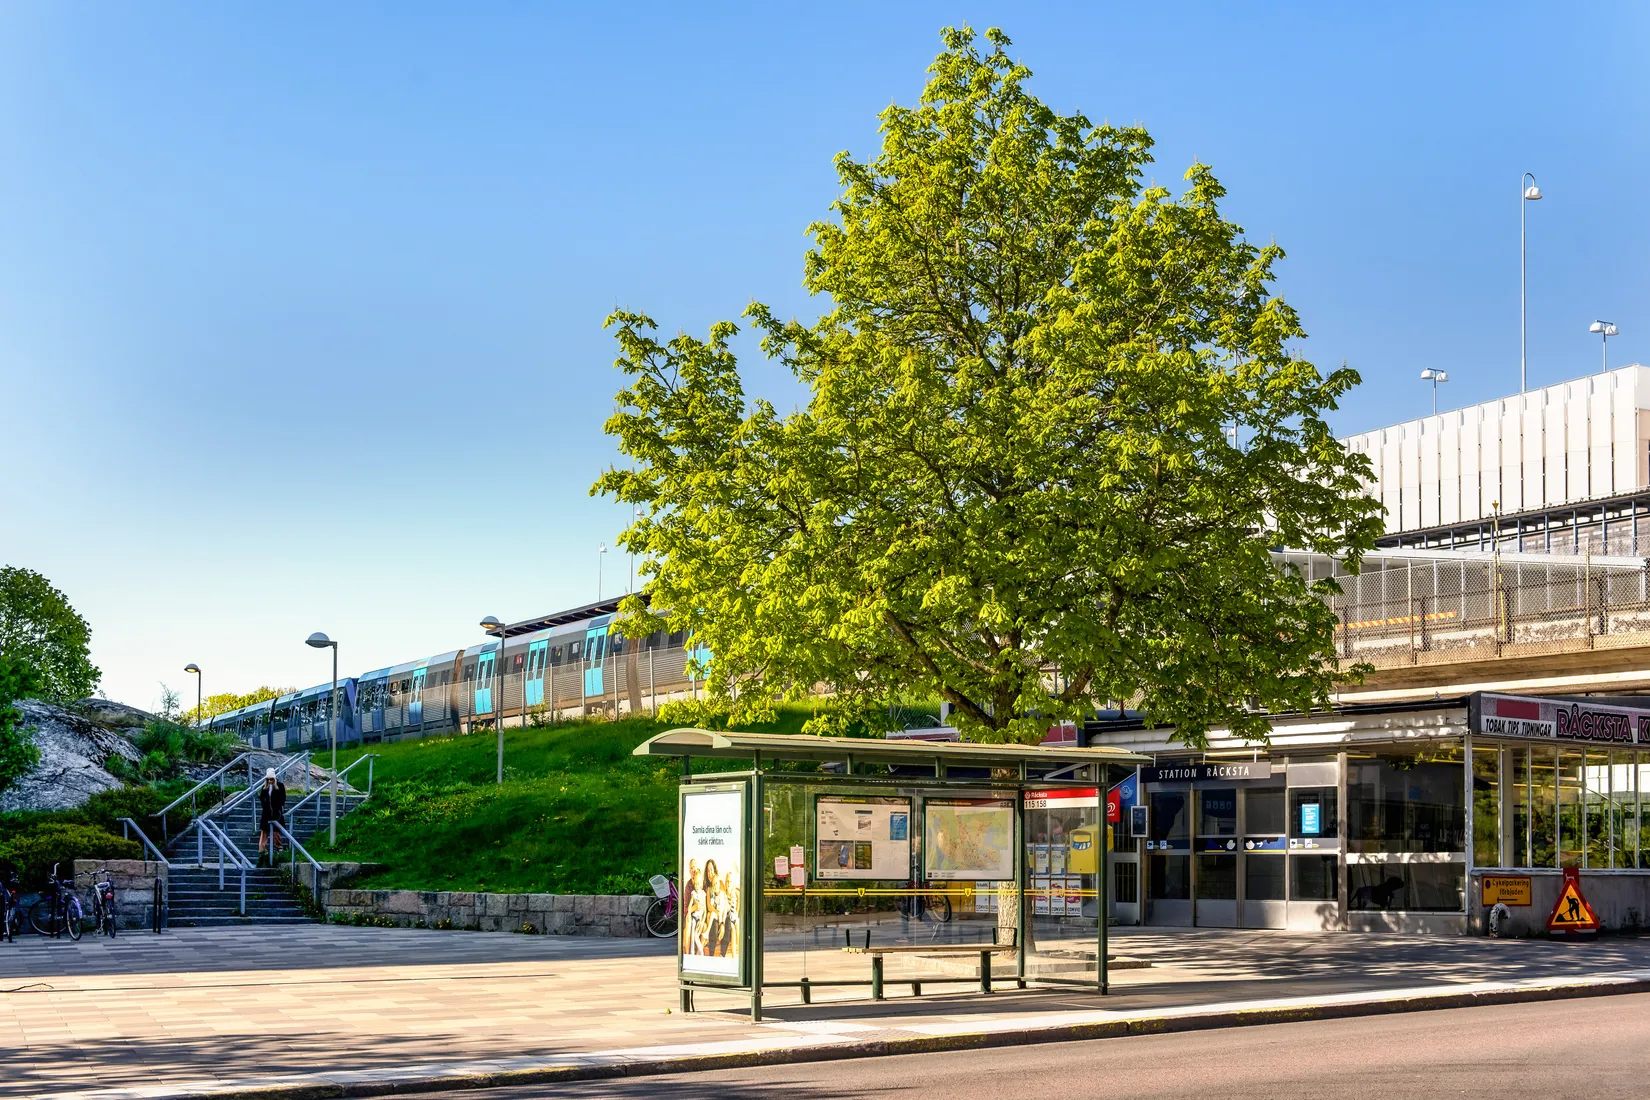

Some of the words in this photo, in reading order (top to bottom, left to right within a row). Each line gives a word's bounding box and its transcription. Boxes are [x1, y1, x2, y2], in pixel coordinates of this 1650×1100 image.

[1557, 703, 1632, 740] RÅCKSTA
[1639, 718, 1650, 741] K
[1486, 719, 1505, 733] TOBAK
[1507, 721, 1519, 735] TIPS
[1522, 722, 1552, 738] TIDNINGAR
[1159, 768, 1197, 779] STATION
[1206, 765, 1250, 777] RÅCKSTA
[1036, 800, 1047, 808] 158
[692, 825, 705, 834] Samla
[705, 825, 715, 833] dina
[723, 825, 732, 833] och
[1492, 879, 1529, 888] Cykelparkering
[1500, 888, 1524, 896] förbjuden
